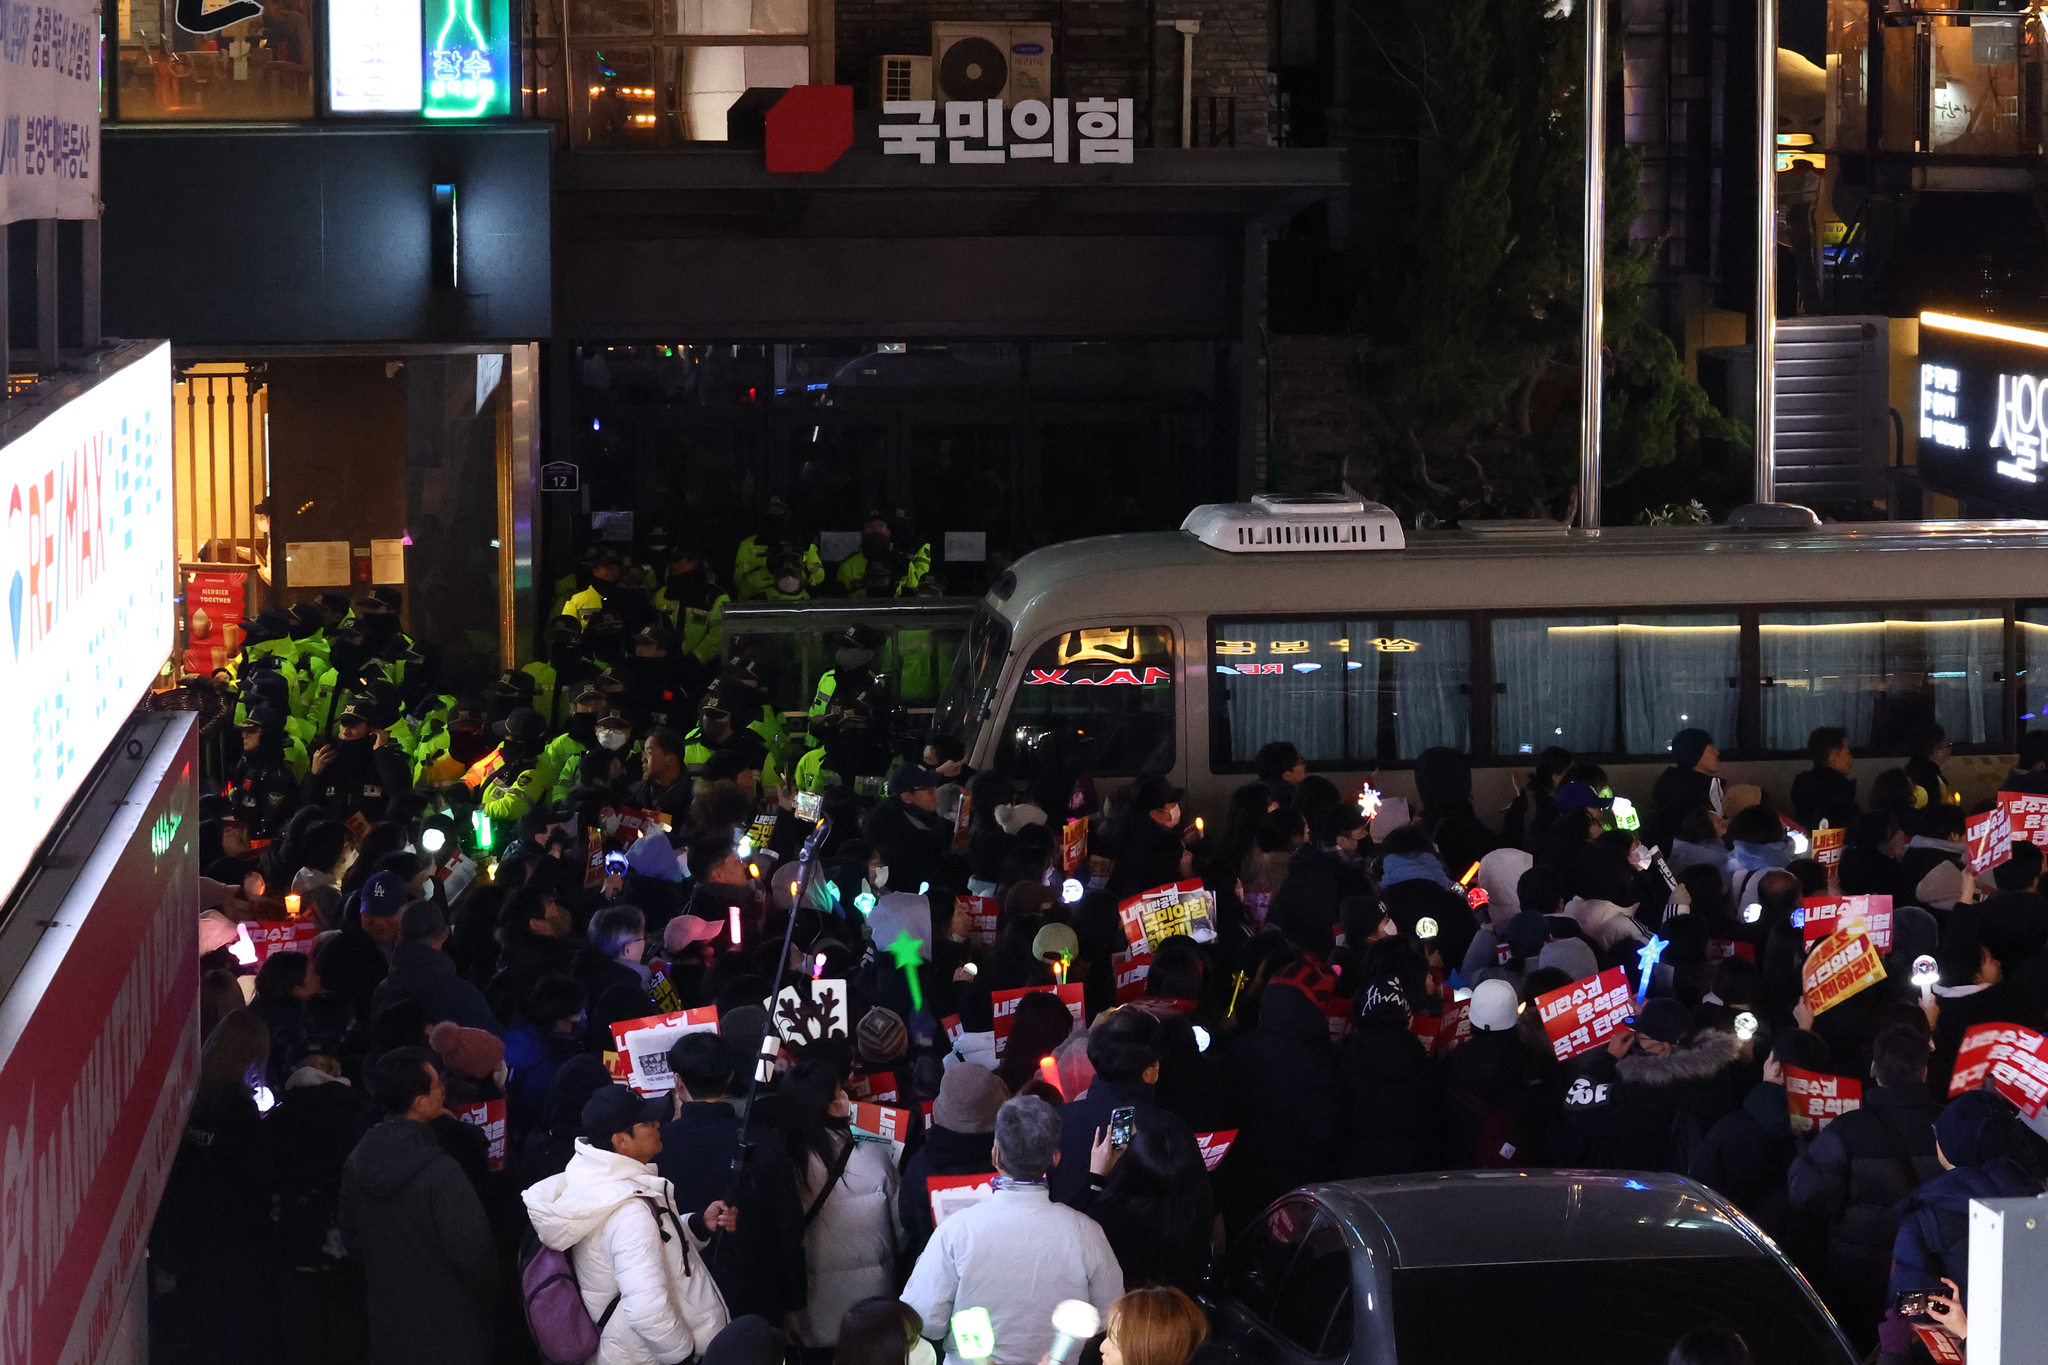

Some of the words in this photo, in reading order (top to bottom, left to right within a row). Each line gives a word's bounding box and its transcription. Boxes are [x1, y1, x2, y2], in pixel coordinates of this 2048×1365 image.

[879, 97, 1133, 164] 국민의힘
[553, 476, 567, 487] 12
[29, 430, 105, 652] RE/MAX
[200, 596, 232, 604] TOGETHER
[202, 588, 229, 596] MERRIER
[374, 882, 385, 898] LA
[1142, 893, 1180, 913] 내란공범
[1143, 897, 1208, 934] 국민의힘
[1540, 974, 1603, 1023] 내란수괴
[1576, 984, 1629, 1025] 윤석열
[1552, 1025, 1590, 1056] 즉각
[1592, 1003, 1635, 1038] 탄핵!
[38, 926, 151, 1306] MANHATTAN
